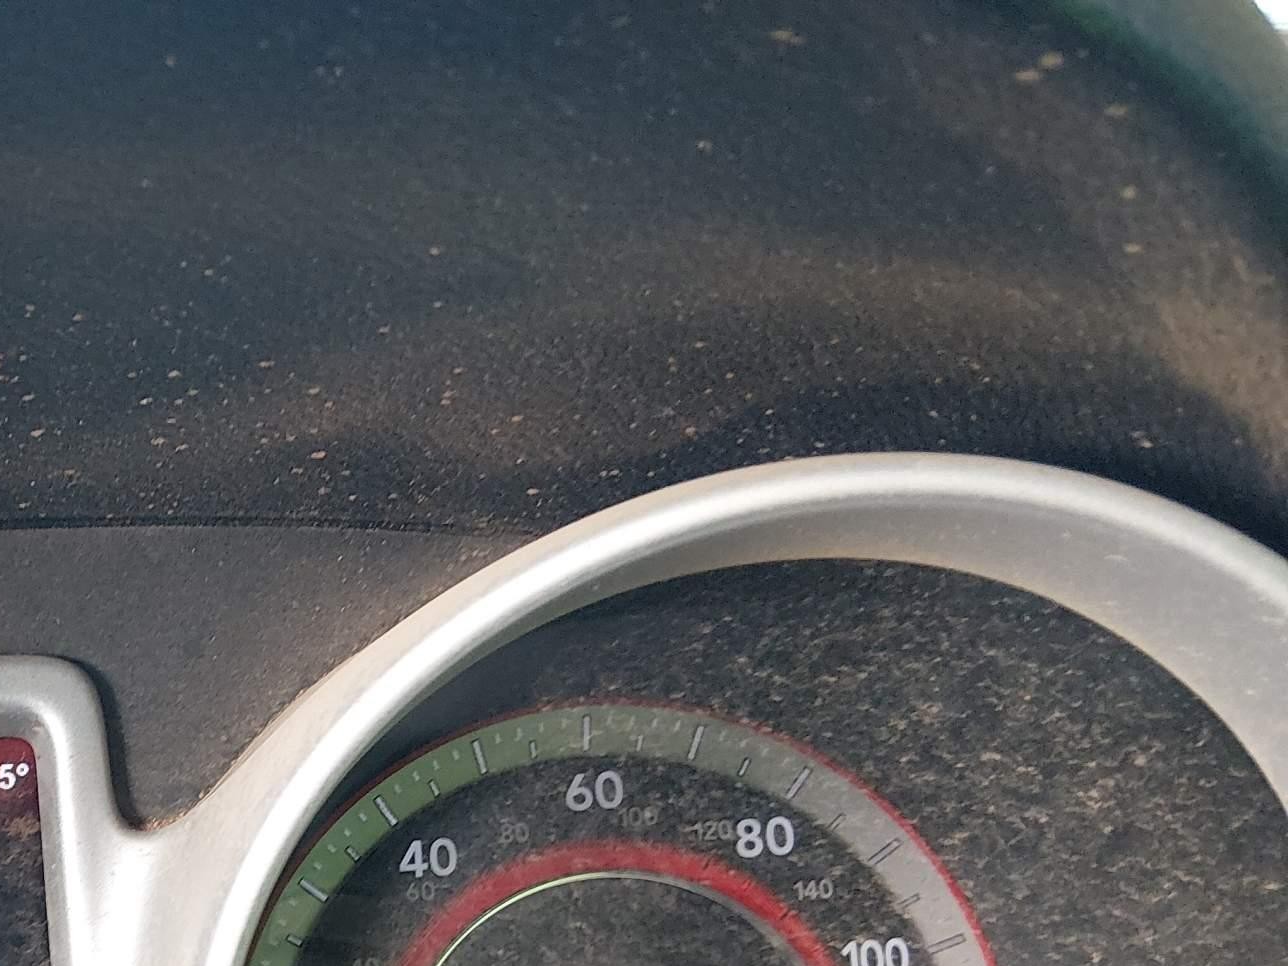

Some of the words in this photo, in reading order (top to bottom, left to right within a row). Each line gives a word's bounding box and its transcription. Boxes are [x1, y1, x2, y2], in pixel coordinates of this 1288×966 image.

[565, 770, 623, 811] 60
[736, 816, 794, 858] 80
[399, 838, 457, 878] 40
[793, 879, 834, 900] 140
